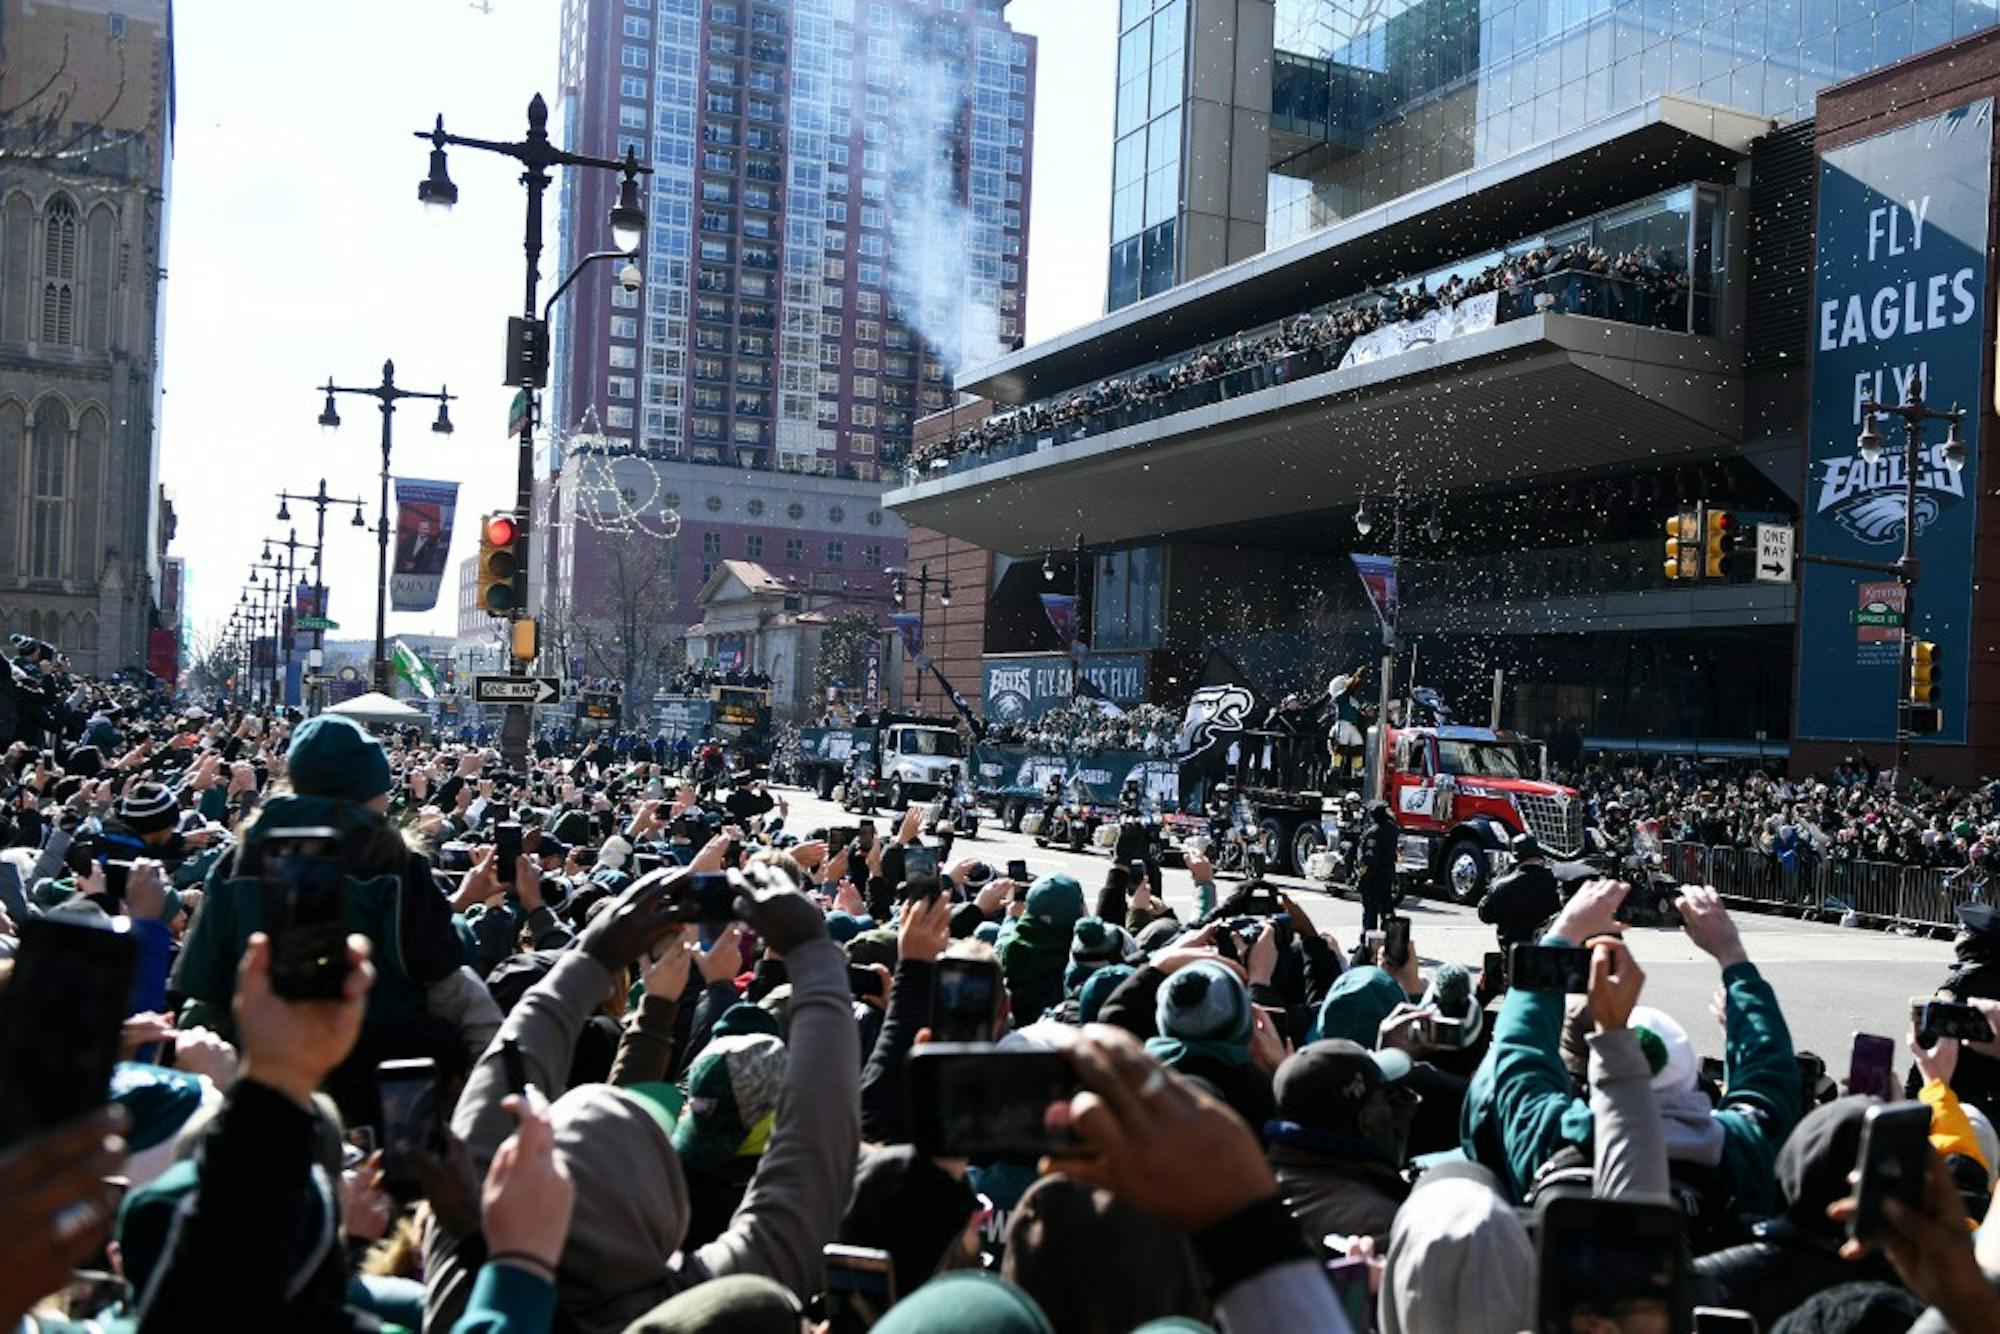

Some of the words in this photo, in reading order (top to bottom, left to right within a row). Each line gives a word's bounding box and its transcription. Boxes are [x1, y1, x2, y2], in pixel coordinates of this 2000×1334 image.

[1868, 195, 1931, 262] FLY
[1820, 267, 1976, 351] EAGLES
[1816, 442, 1965, 514] EAGLES
[1763, 529, 1786, 544] ONE
[1763, 545, 1786, 558] WAY
[483, 683, 507, 695] ONE
[867, 656, 878, 700] PARK
[1035, 669, 1056, 697] FLY
